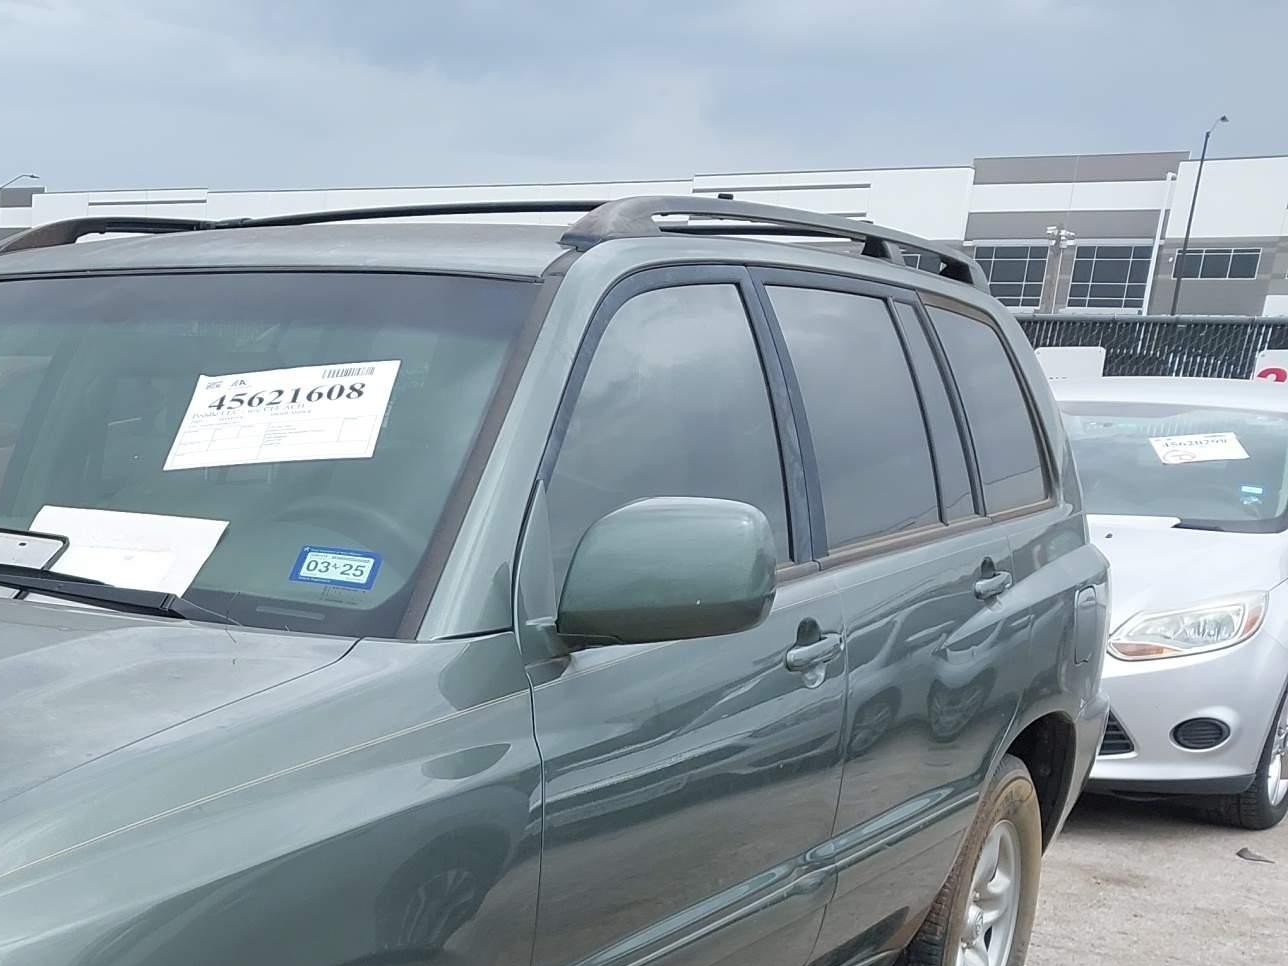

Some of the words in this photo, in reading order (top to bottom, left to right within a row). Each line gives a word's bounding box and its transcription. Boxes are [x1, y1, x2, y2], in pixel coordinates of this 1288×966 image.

[208, 382, 366, 412] 45621608
[306, 559, 331, 574] 03
[339, 563, 366, 578] 25
